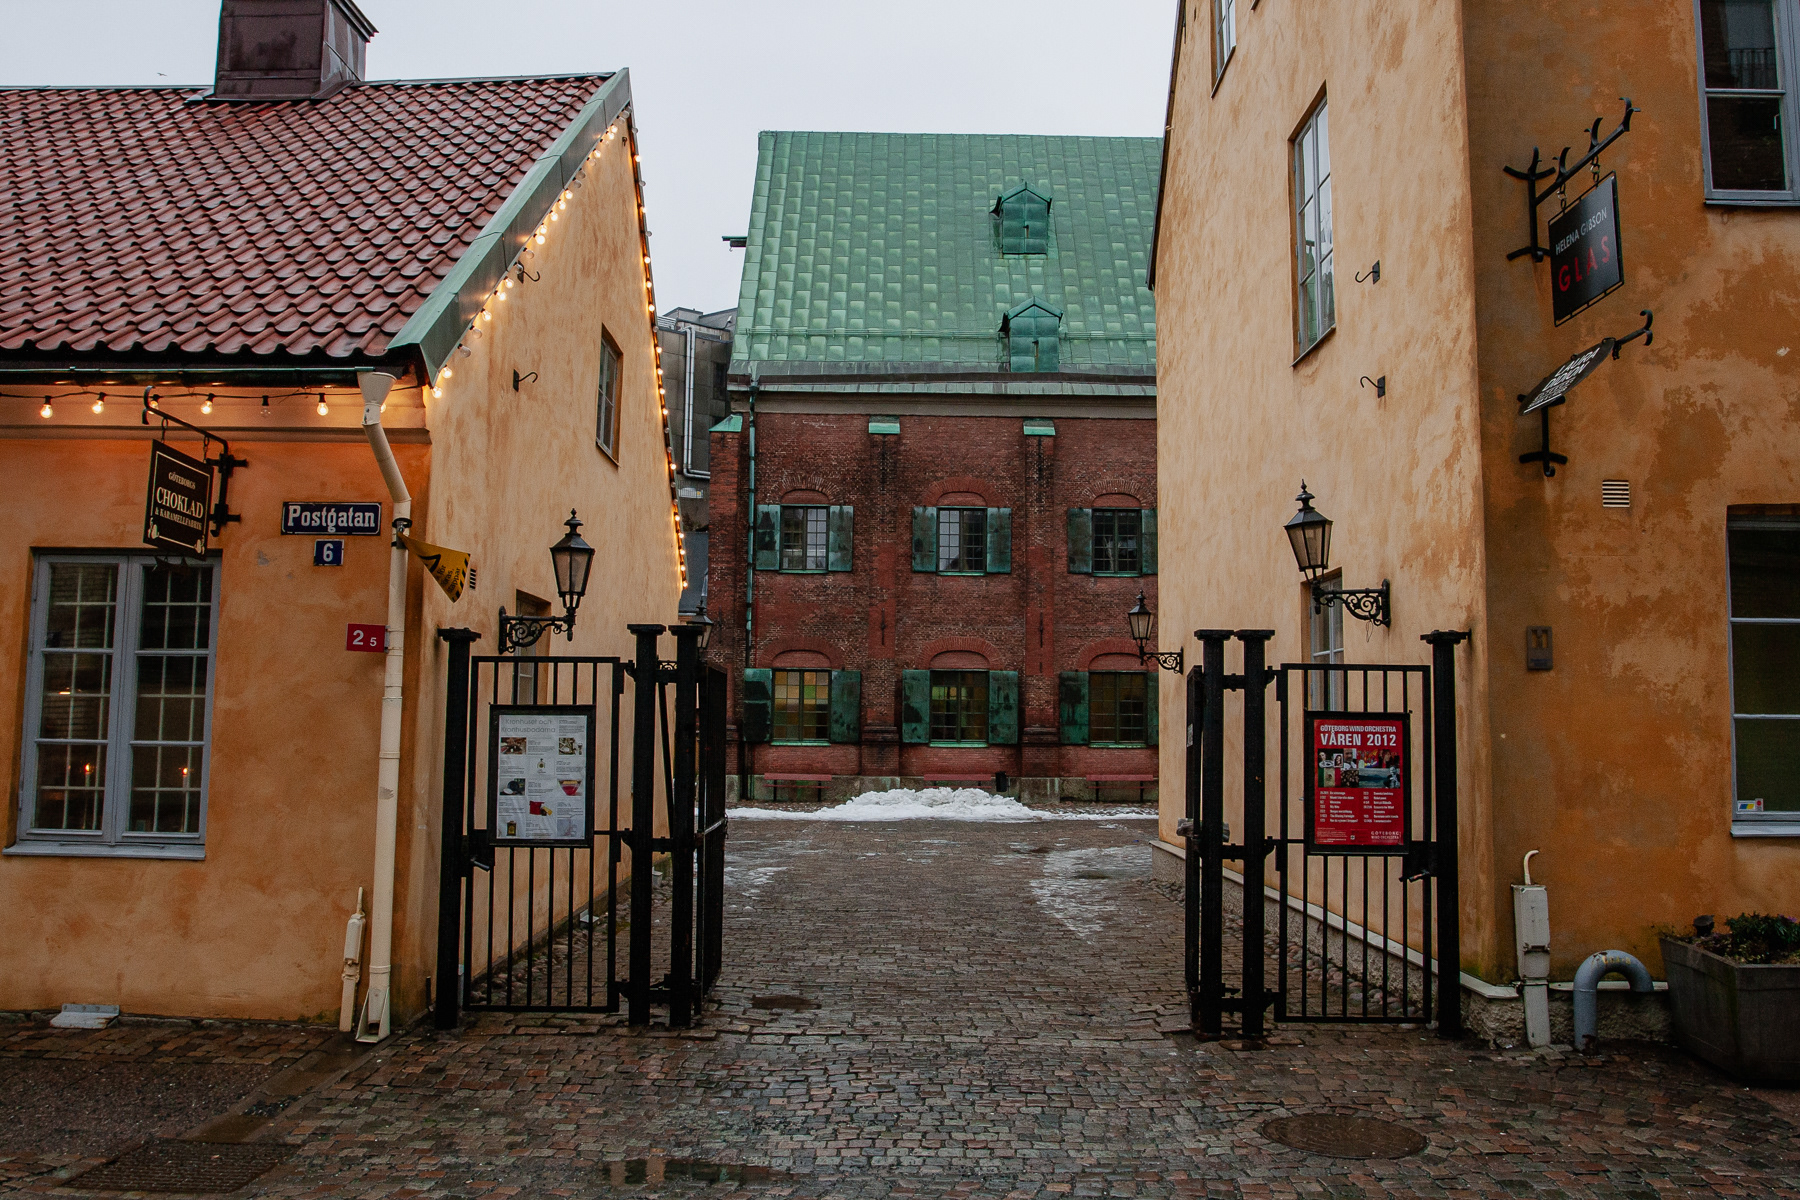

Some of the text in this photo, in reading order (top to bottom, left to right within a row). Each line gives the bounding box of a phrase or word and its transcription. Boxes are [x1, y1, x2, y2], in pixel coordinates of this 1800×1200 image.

[1555, 207, 1607, 255] HELENA GIBSON
[1558, 235, 1610, 292] GLAS
[168, 471, 196, 490] GÖTEBORGS
[156, 486, 204, 519] CHOKLAD
[154, 506, 202, 531] & KARAMELLFABRIK
[287, 505, 376, 533] Postgatan
[322, 542, 334, 562] 6
[352, 629, 377, 647] 2 5
[1320, 724, 1349, 732] GÖTEBORG
[1365, 725, 1397, 733] ORCHESTRA
[1320, 731, 1397, 746] VÅREN 2012
